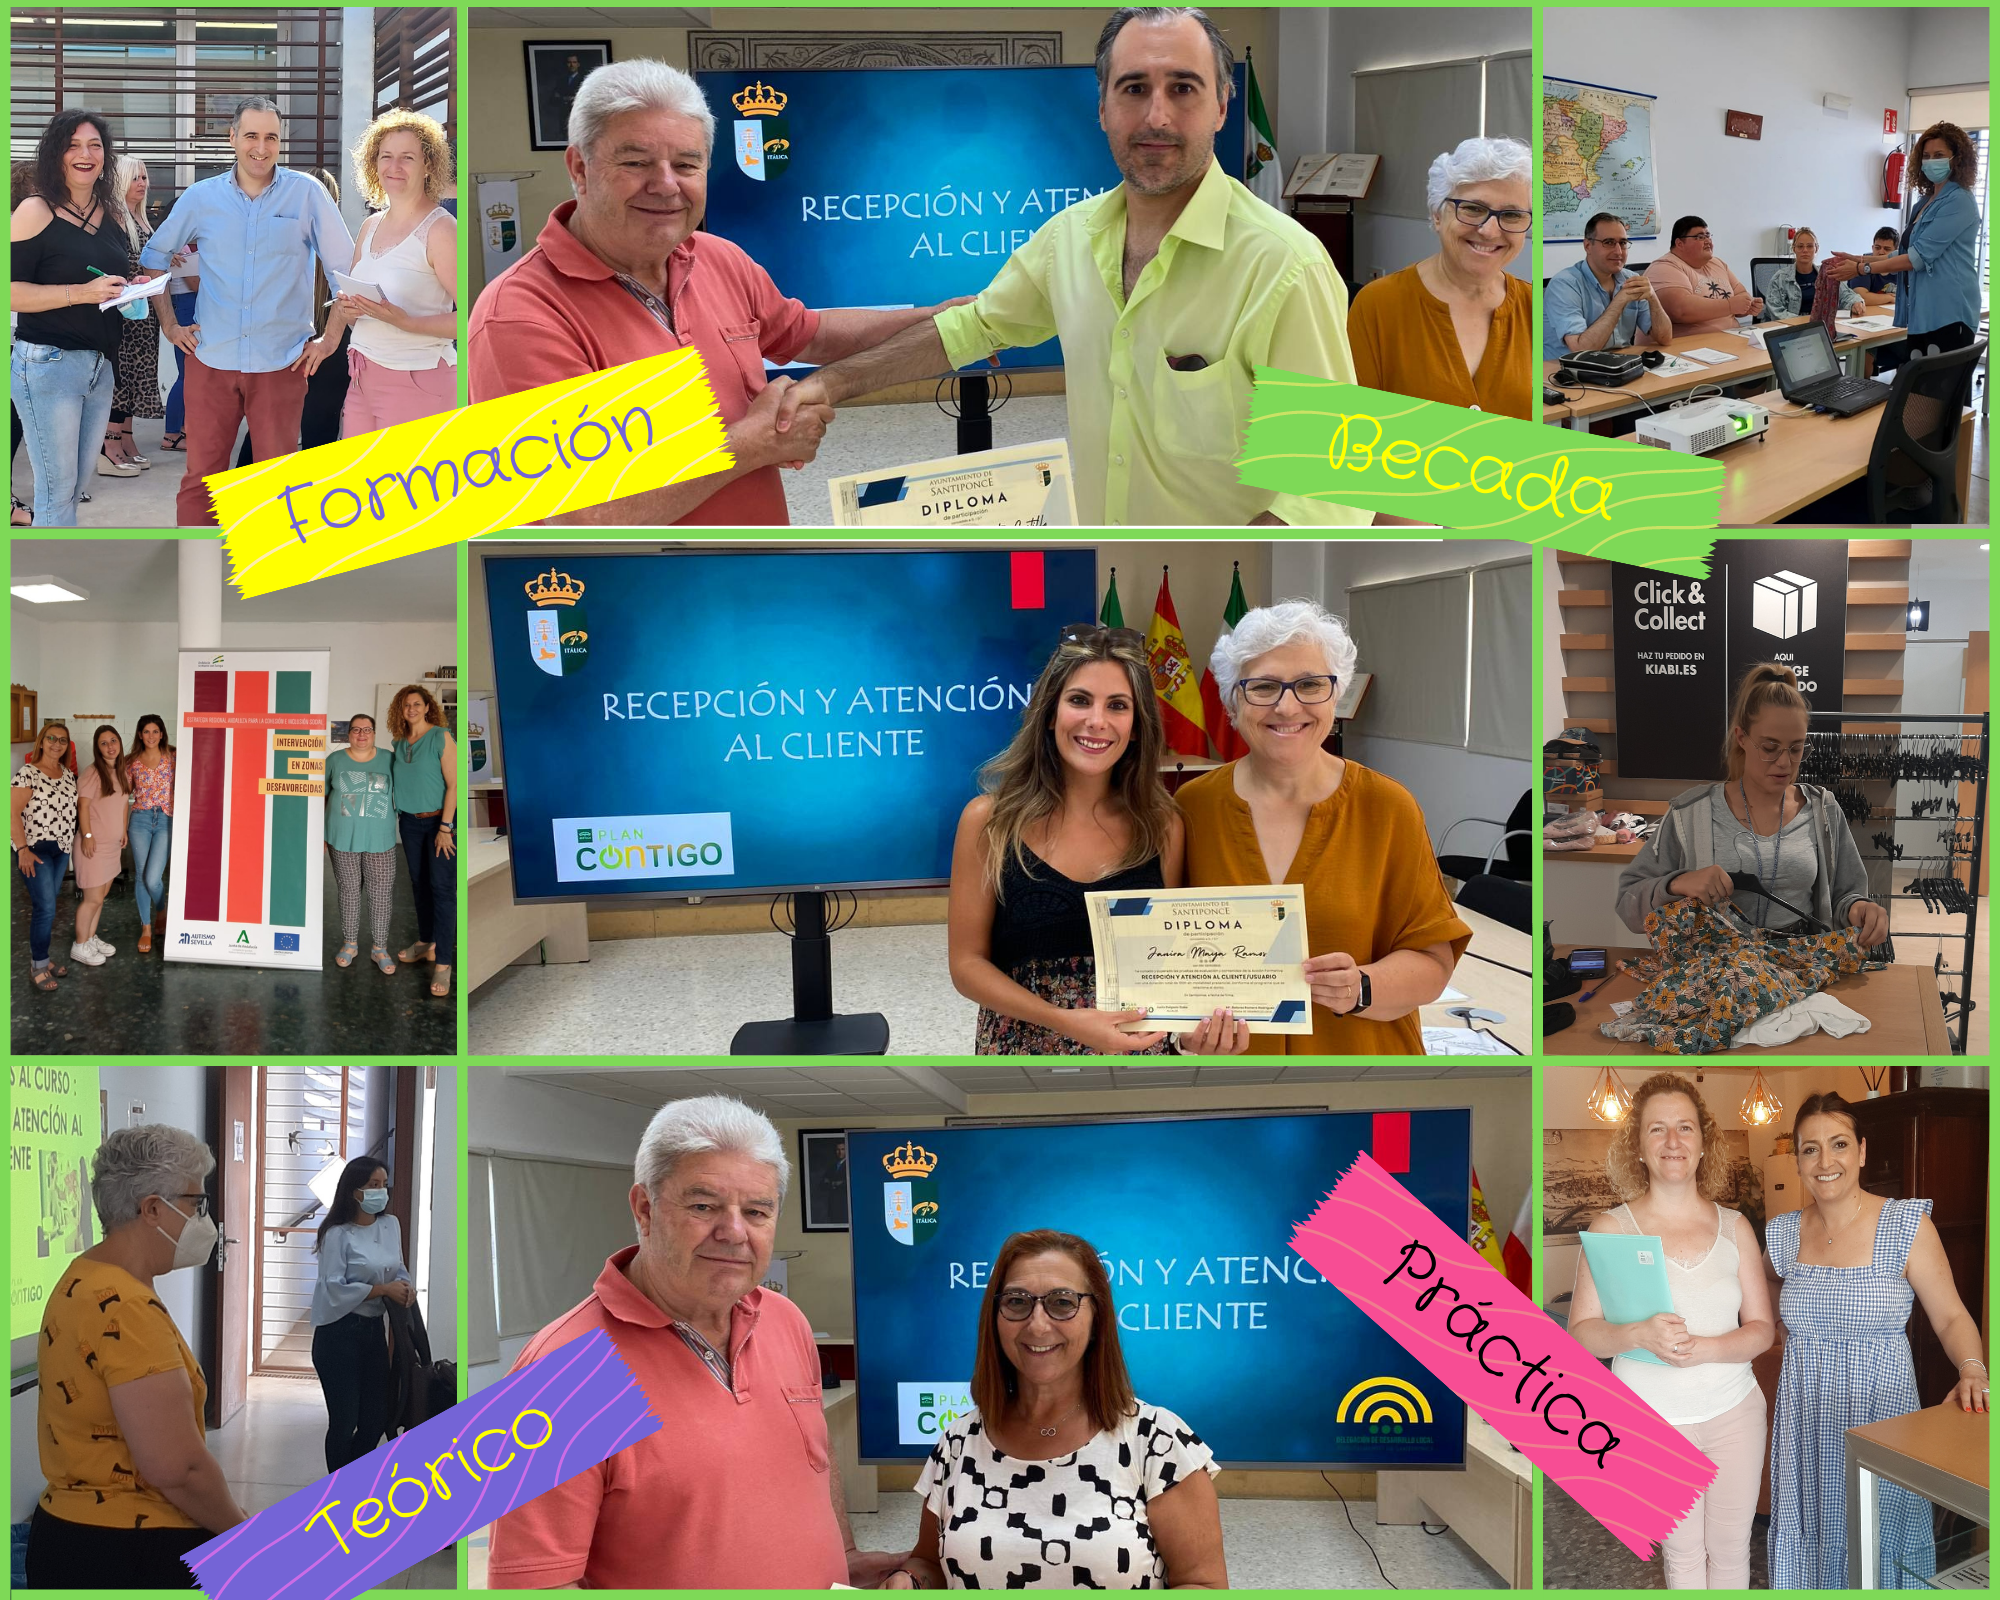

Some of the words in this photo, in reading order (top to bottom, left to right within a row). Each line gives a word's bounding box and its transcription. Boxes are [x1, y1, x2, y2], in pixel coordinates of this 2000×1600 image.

[801, 185, 983, 221] RECEPCIÓN
[992, 190, 1011, 215] Y
[909, 232, 953, 259] AL
[960, 229, 1036, 257] CLIE
[929, 472, 982, 486] AYUNTAMIENTO
[930, 477, 994, 496] SANTIPONCE
[921, 491, 1008, 516] DIPLOMA
[951, 508, 989, 519] participación
[1633, 579, 1686, 604] Click
[1687, 581, 1706, 604] &
[1634, 606, 1707, 631] Collect
[1637, 651, 1653, 660] HAZ
[1655, 652, 1664, 660] TU
[1665, 652, 1692, 660] PEDIDO
[1694, 652, 1705, 661] EN
[1774, 653, 1794, 661] AQUI
[1645, 664, 1697, 676] KIABI.ES
[603, 681, 806, 721] RECEPCIÓN
[814, 688, 837, 715] Y
[847, 676, 1032, 715] ATENCIÓN
[276, 737, 324, 748] INTERVENCIÓN
[724, 733, 773, 762] AL
[781, 729, 924, 760] CLIENTE
[291, 761, 300, 770] EN
[301, 761, 323, 771] ZONAS
[266, 782, 323, 793] DESFAVORECIDAS
[598, 828, 644, 841] PLAN
[1172, 907, 1230, 916] SANTIPONCE
[1164, 920, 1243, 930] DIPLOMA
[1190, 946, 1227, 963] Maya
[1232, 945, 1267, 958] Ramos
[19, 1066, 31, 1088] AL
[34, 1066, 70, 1094] CURSO
[71, 1114, 83, 1136] AL
[1160, 1258, 1178, 1285] Y
[1186, 1254, 1328, 1286] ATENC
[1117, 1301, 1269, 1332] CLIENTE
[939, 1395, 970, 1406] PLA
